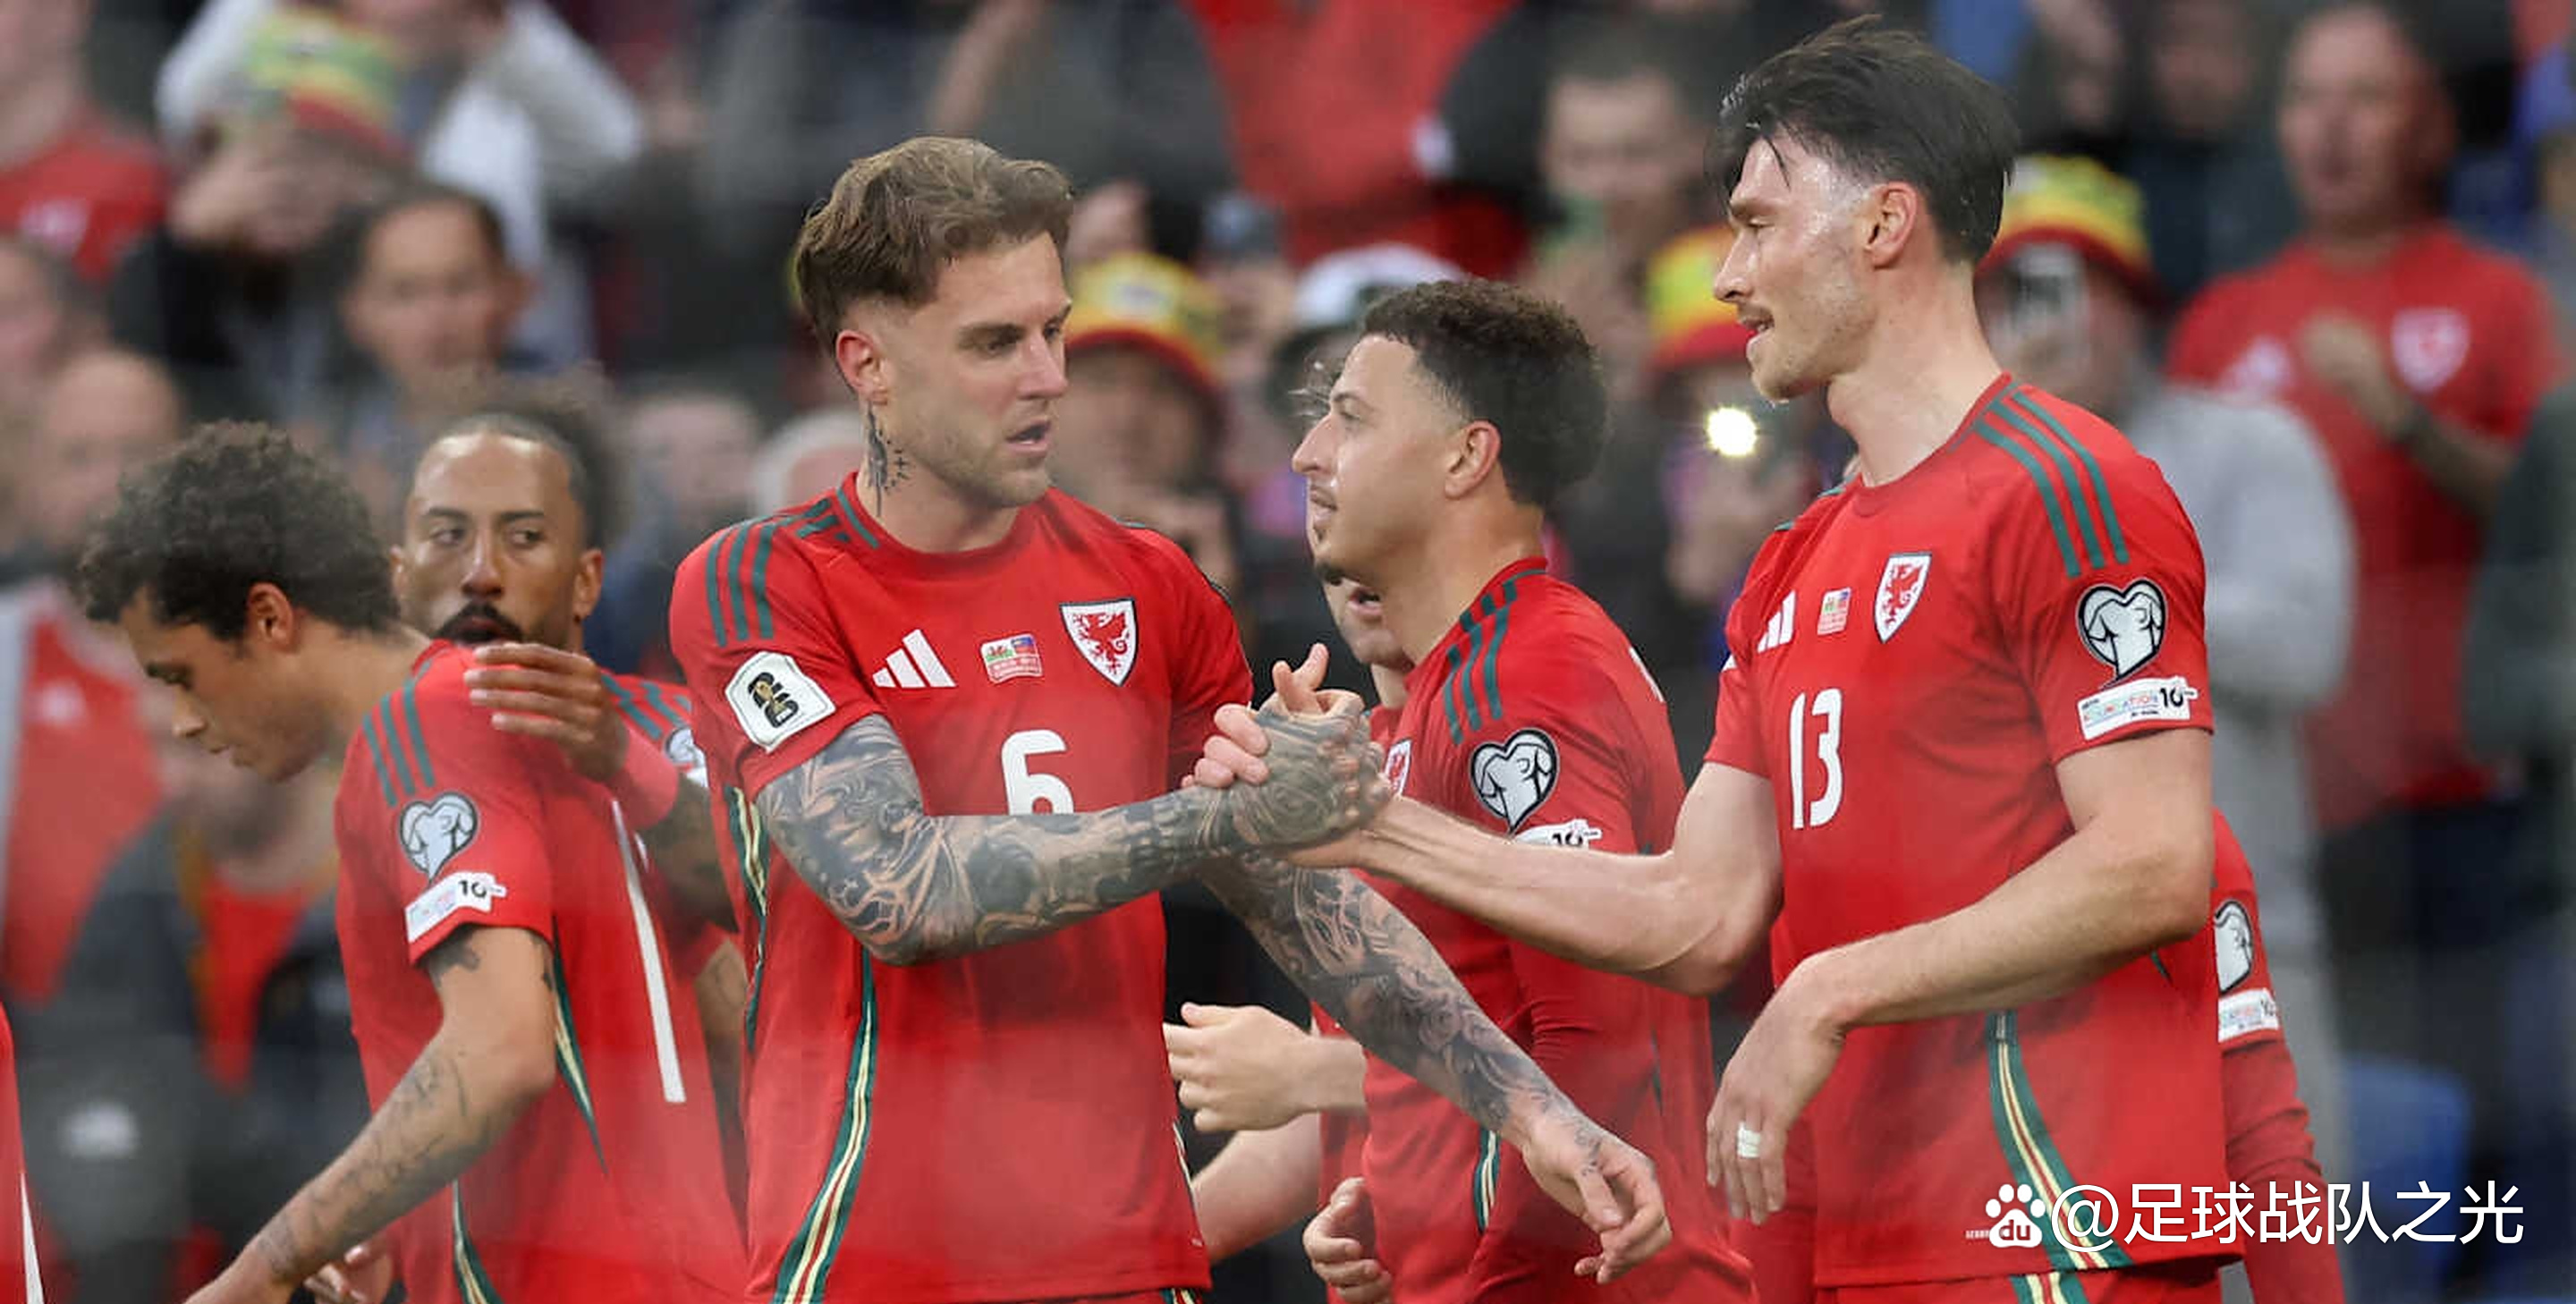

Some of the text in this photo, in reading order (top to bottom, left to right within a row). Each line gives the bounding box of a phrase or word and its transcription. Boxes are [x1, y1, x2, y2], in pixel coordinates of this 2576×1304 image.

[2159, 687, 2184, 707] 10
[1001, 729, 1074, 816] 6
[1790, 688, 1843, 829] 13
[458, 880, 487, 899] 10
